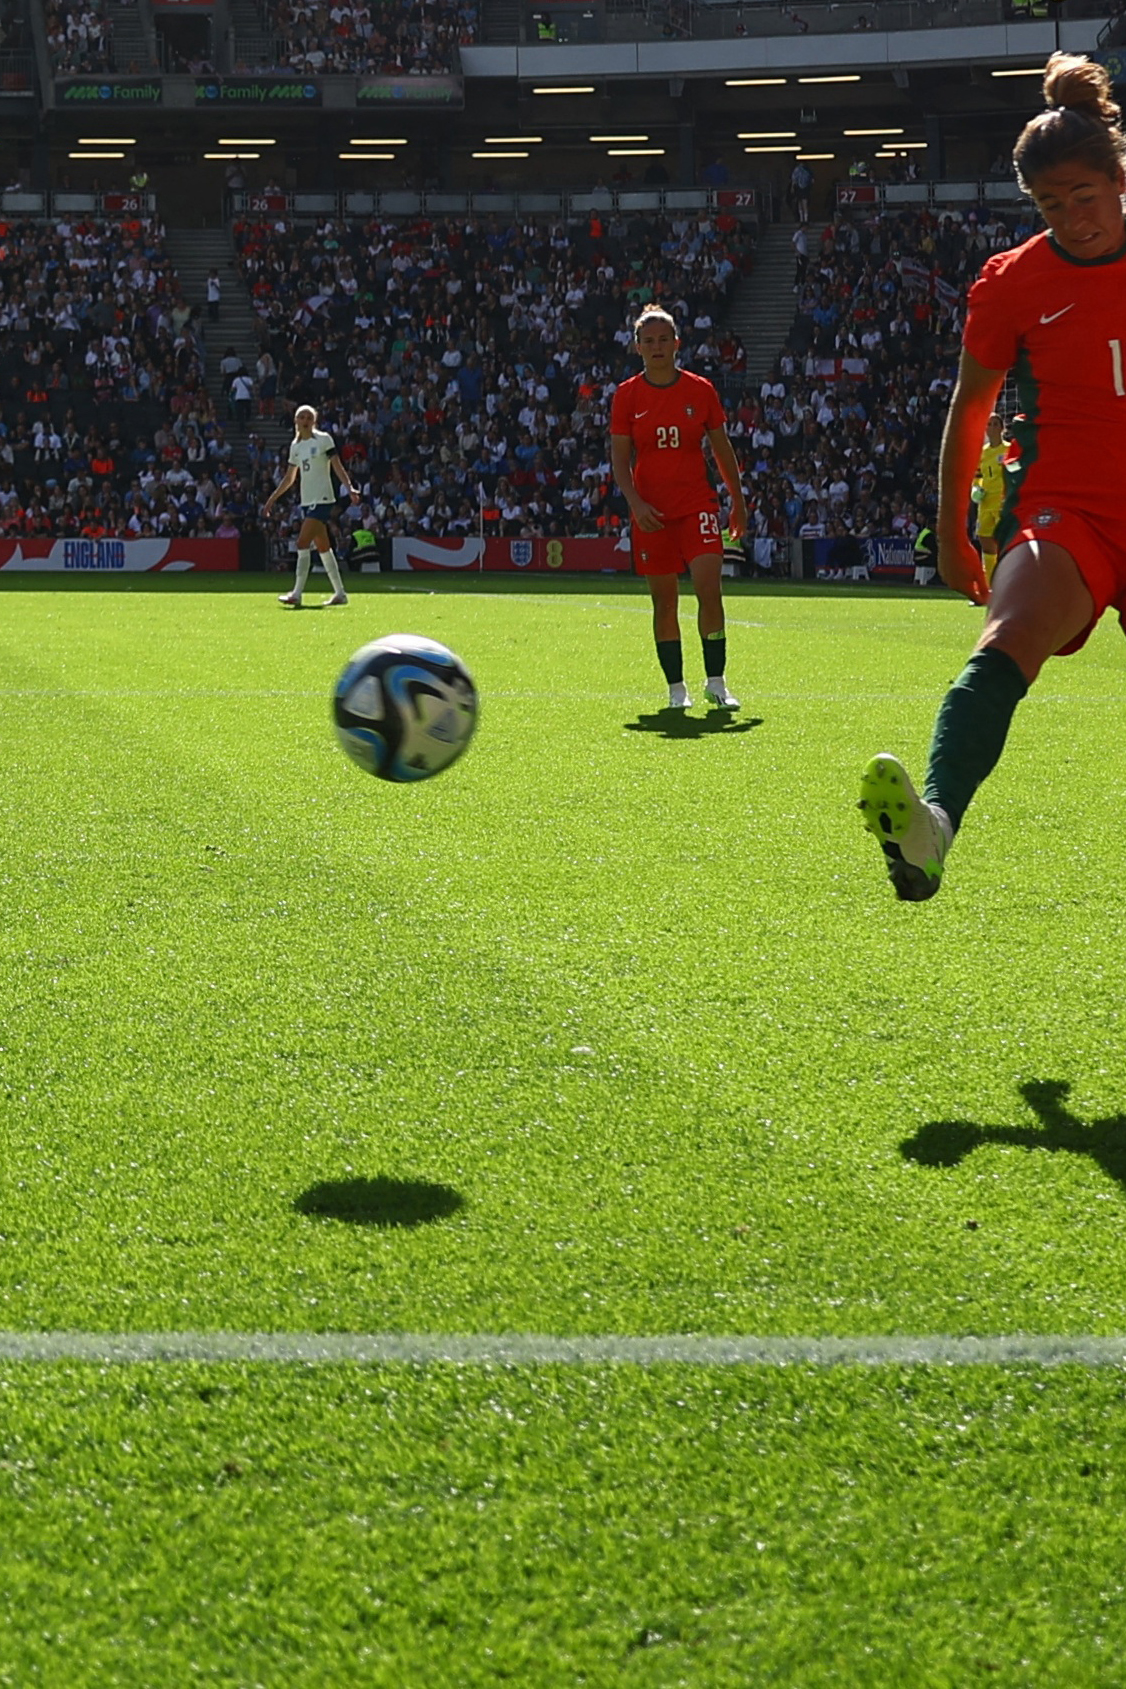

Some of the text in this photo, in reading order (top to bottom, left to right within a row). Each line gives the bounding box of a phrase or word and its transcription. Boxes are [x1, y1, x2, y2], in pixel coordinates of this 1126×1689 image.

[113, 85, 161, 102] Family
[220, 84, 267, 103] Family
[122, 199, 138, 211] 26
[252, 199, 268, 211] 26
[735, 193, 752, 206] 27
[840, 191, 857, 204] 27
[656, 426, 680, 449] 23
[302, 459, 311, 472] 15
[699, 512, 719, 535] 23
[64, 541, 125, 569] ENGLAND
